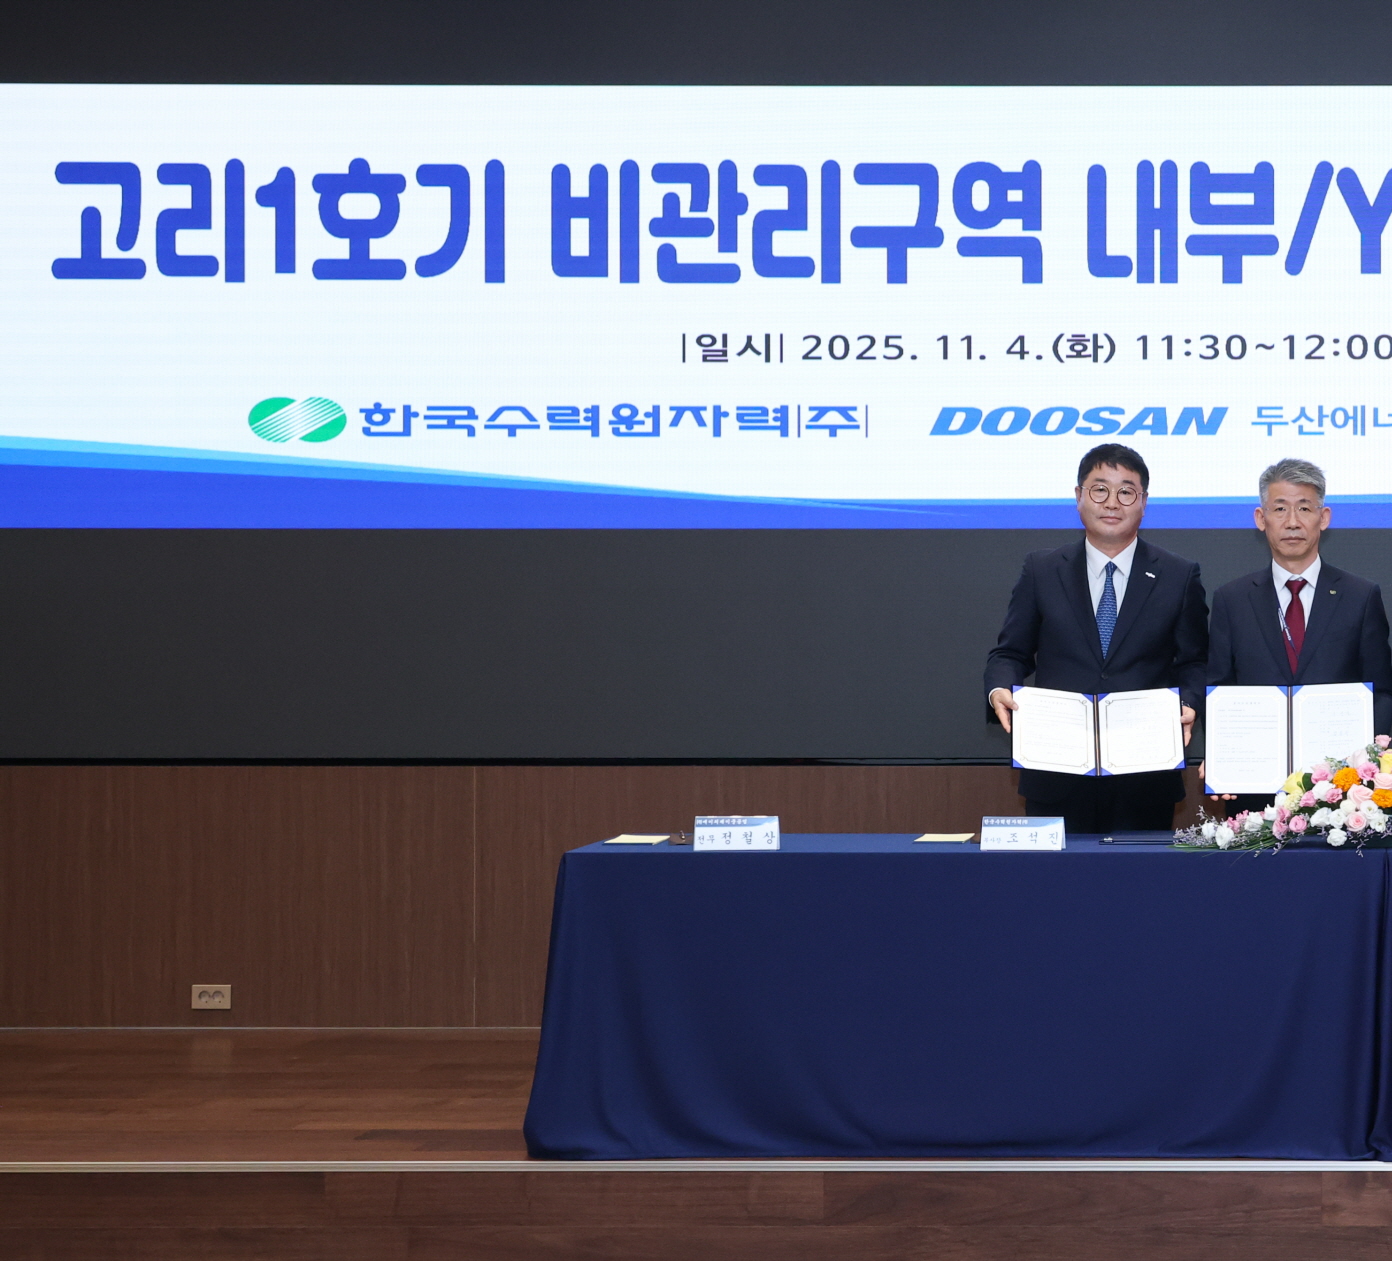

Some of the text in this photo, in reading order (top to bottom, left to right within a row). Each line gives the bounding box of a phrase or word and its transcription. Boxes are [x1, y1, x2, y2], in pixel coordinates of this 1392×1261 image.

[51, 158, 505, 283] 고리1호기
[551, 160, 1043, 284] 비관리구역
[801, 335, 919, 361] 2025.
[936, 335, 987, 361] 11.
[929, 406, 1229, 436] DOOSAN
